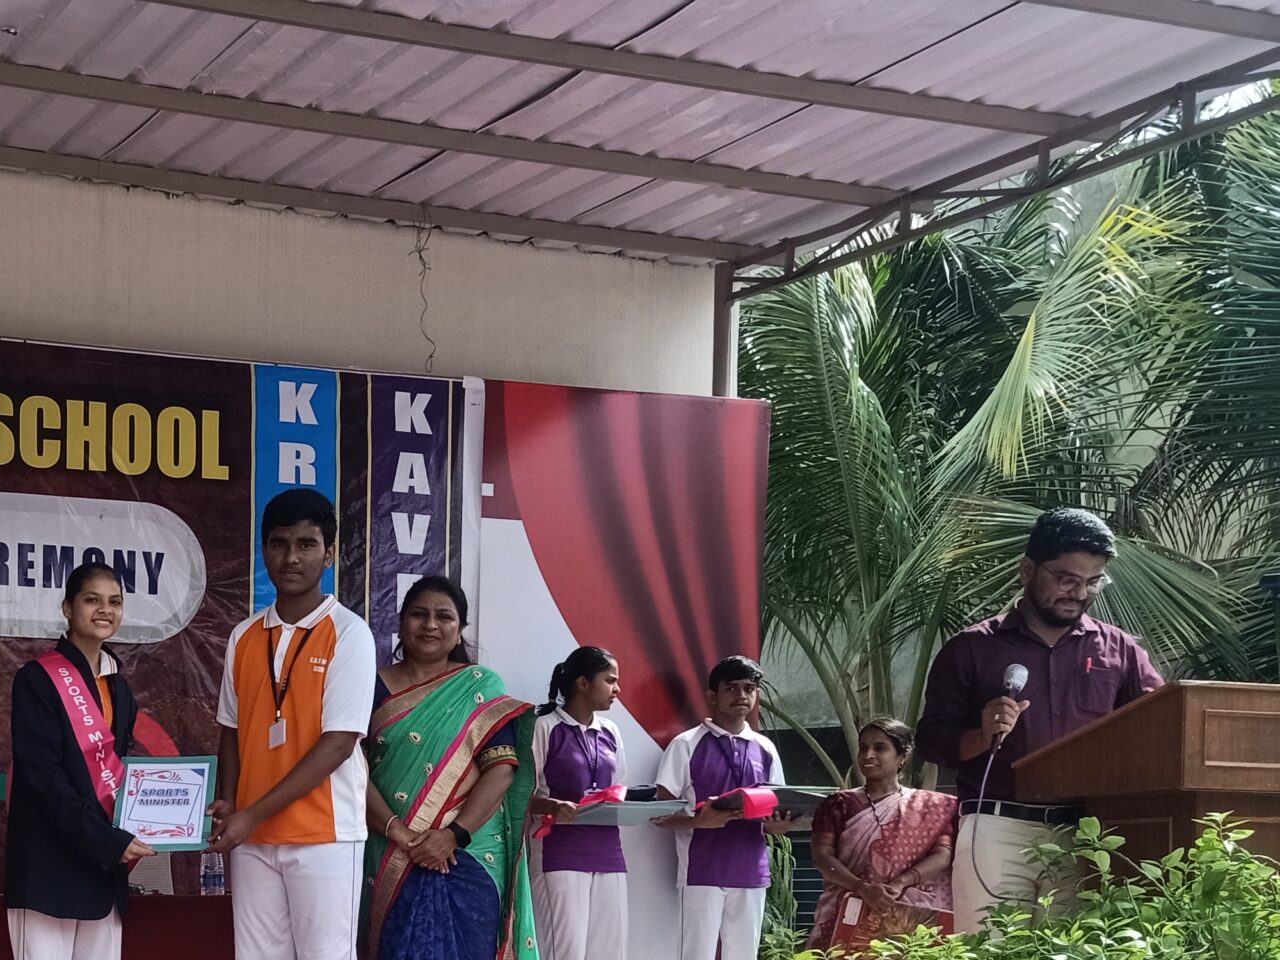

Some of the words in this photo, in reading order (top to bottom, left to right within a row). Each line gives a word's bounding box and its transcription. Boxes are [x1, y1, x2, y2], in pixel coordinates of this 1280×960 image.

[58, 667, 94, 726] SPORTS
[140, 788, 189, 797] SPORTS
[137, 798, 190, 806] MINISTER
